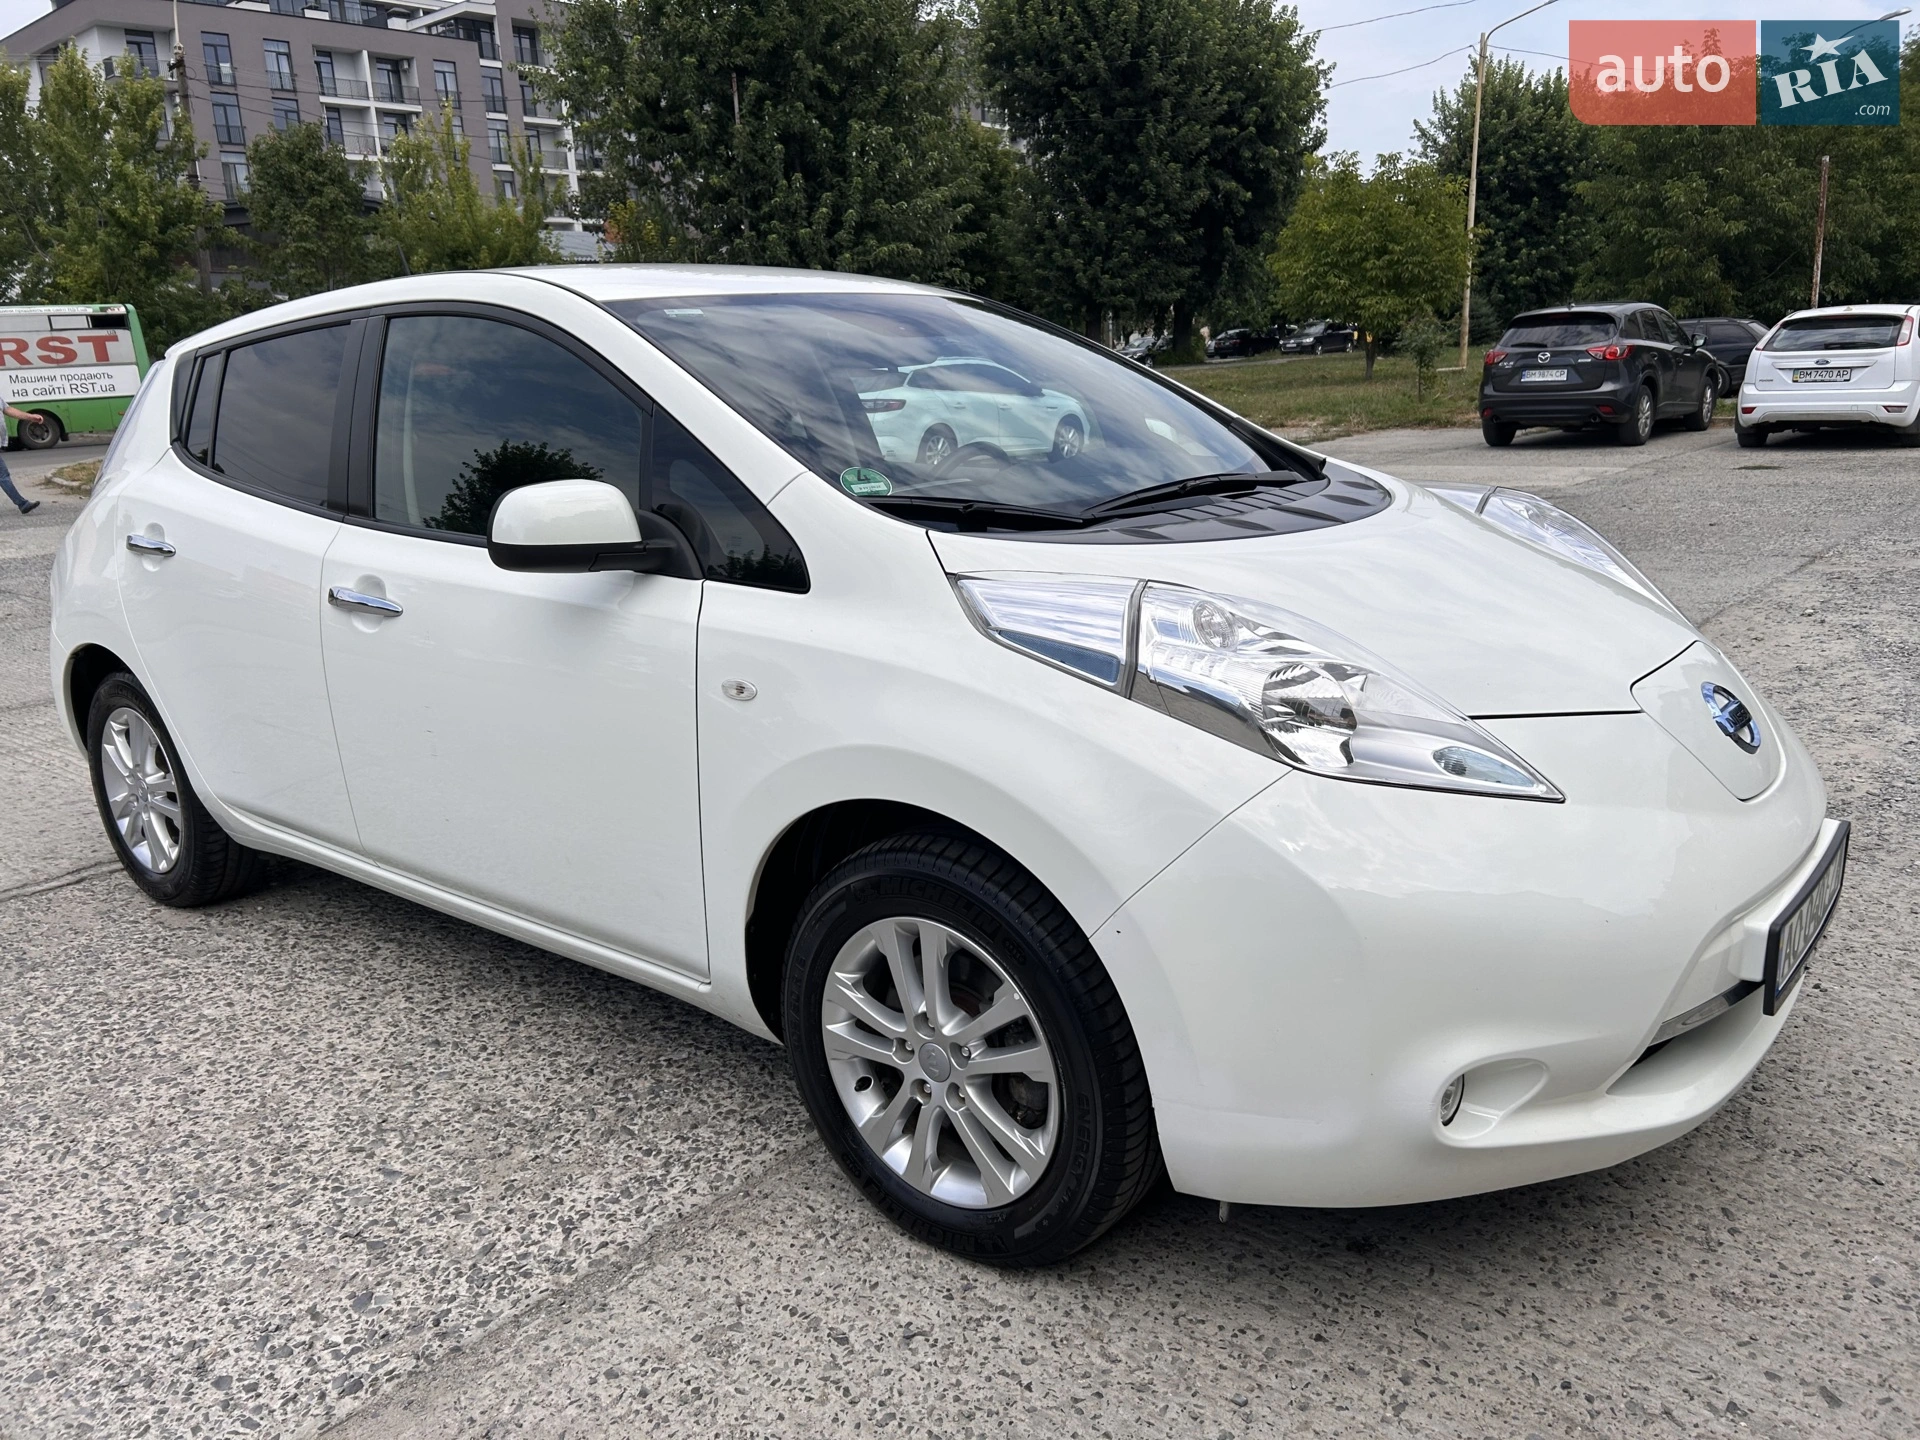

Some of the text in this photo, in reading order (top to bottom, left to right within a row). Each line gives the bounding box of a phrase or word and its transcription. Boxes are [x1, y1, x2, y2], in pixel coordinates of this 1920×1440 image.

[0, 335, 119, 366] RST
[8, 372, 113, 384] Машини продають
[1538, 370, 1553, 378] 9874
[1799, 370, 1849, 379] BM 7470 AP
[12, 382, 116, 397] на сайті RST.ua
[878, 876, 1002, 937] MICHELIN
